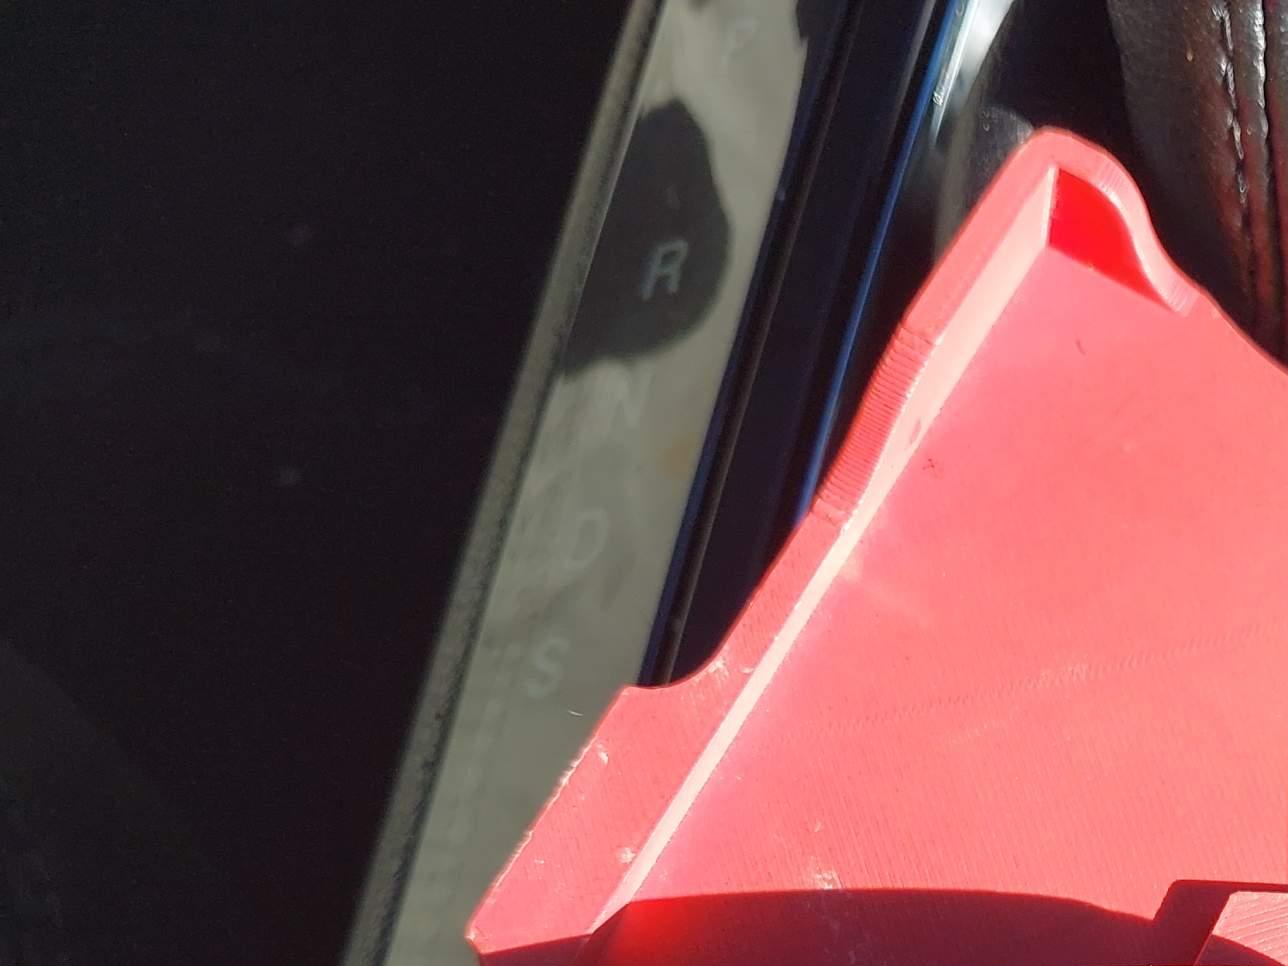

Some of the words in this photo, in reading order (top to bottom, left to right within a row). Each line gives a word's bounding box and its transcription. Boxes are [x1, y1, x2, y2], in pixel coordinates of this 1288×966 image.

[641, 238, 689, 300] R
[563, 506, 609, 571] D
[525, 631, 570, 699] S
